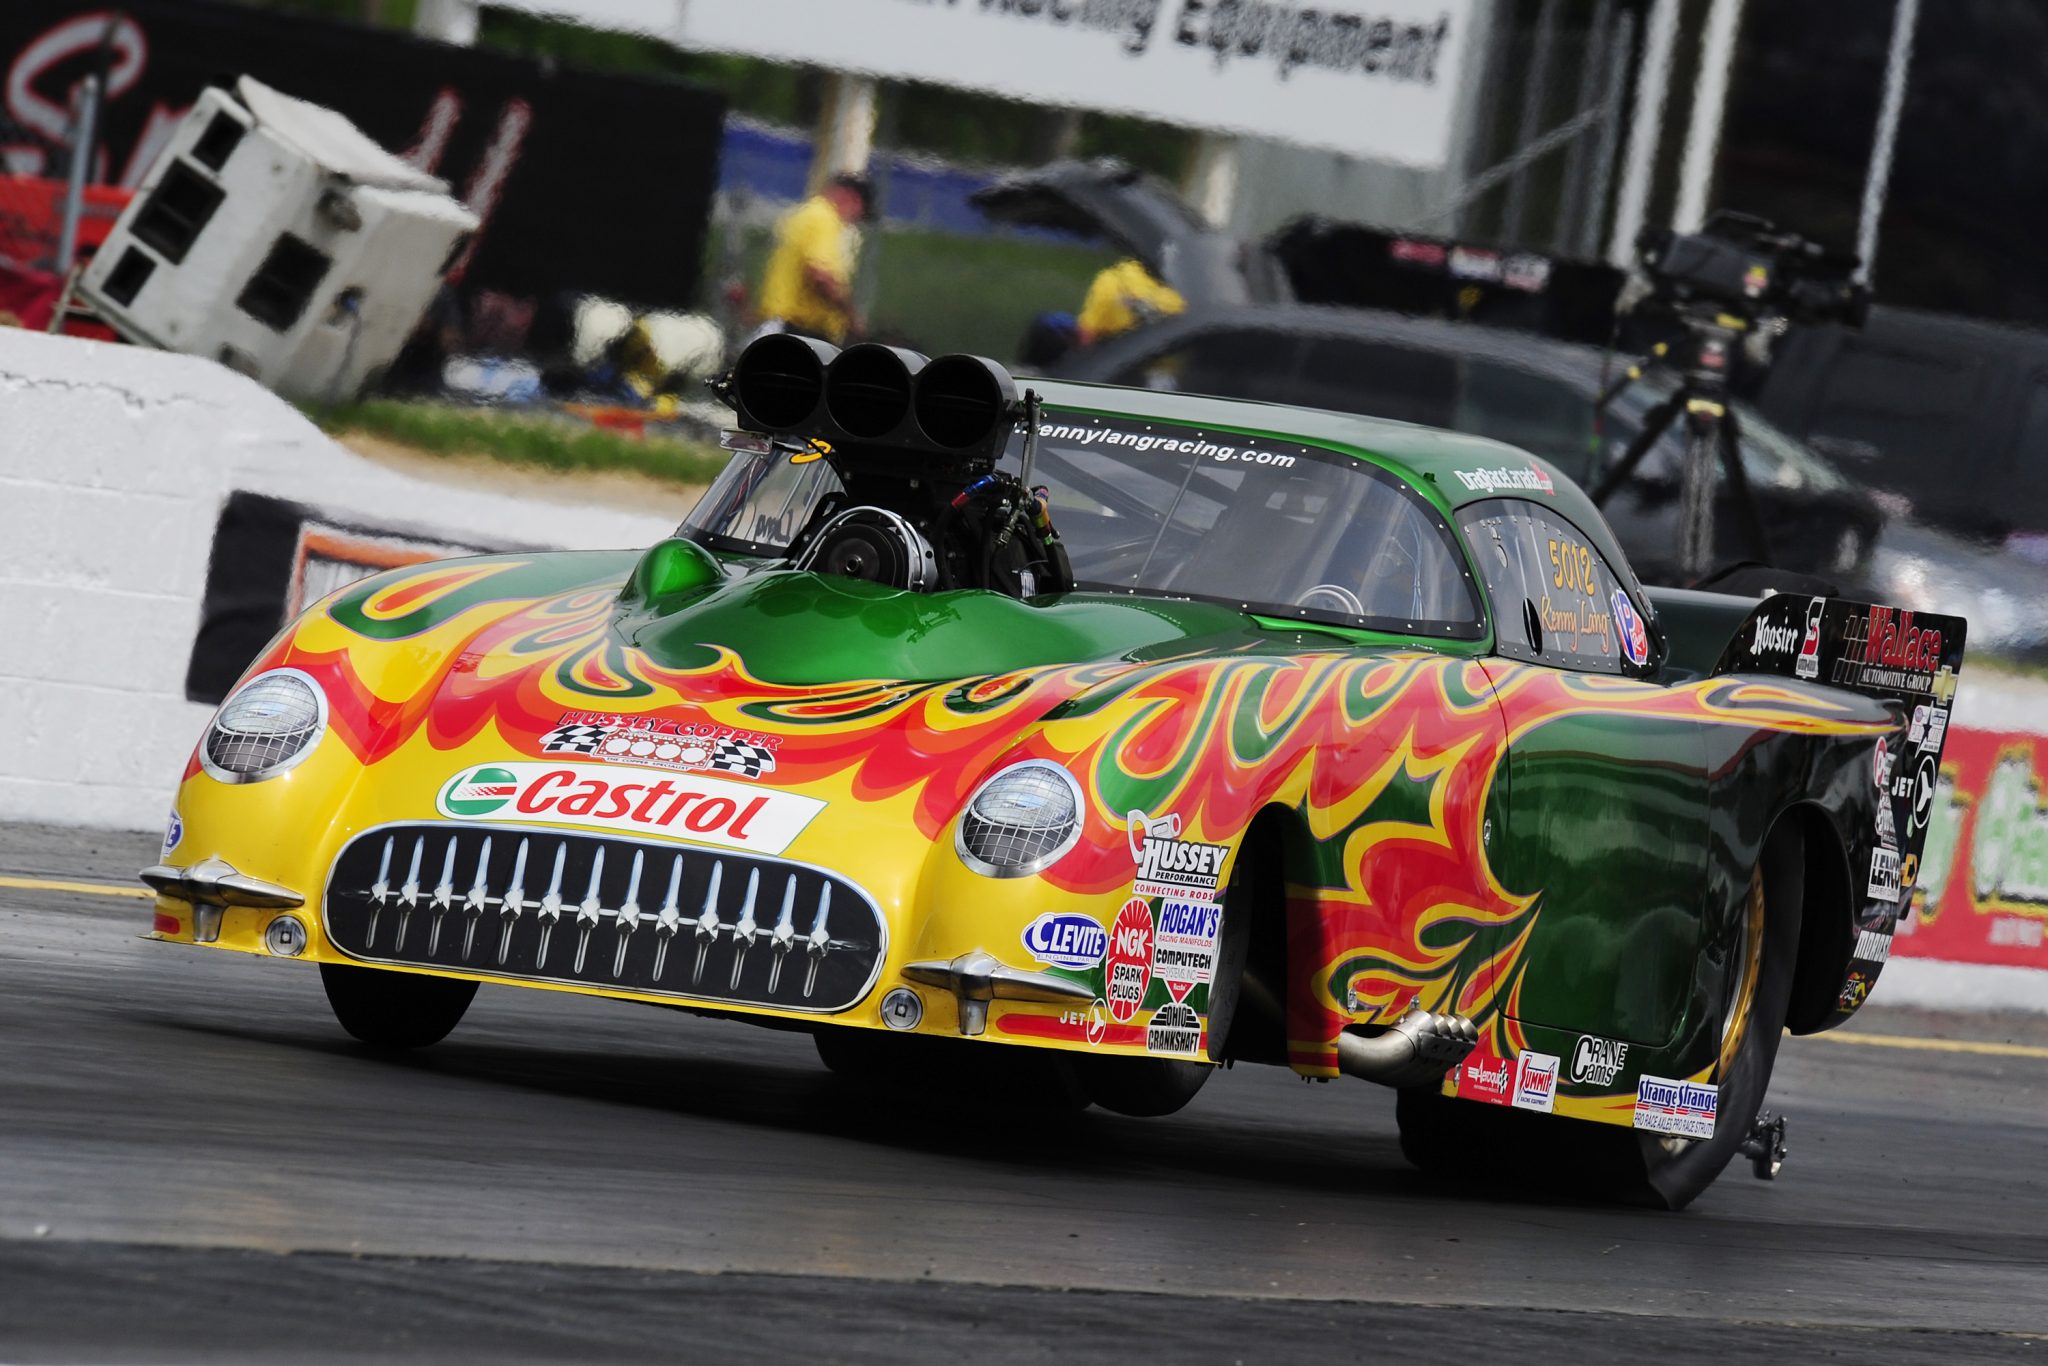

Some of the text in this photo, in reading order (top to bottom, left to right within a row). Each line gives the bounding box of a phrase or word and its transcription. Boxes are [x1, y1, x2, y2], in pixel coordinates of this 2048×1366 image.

[1549, 539, 1595, 596] 5012
[1541, 596, 1610, 654] Kenny Lang
[1750, 616, 1798, 655] Hoosier
[1865, 604, 1942, 672] Wallace
[1861, 668, 1932, 692] AUTOMOTIVE GROUP
[557, 711, 784, 750] HUSSEY COPPER
[1892, 776, 1914, 798] JET
[516, 770, 769, 840] Castrol
[1137, 838, 1229, 880] HUSSEY
[1134, 883, 1214, 901] CONNECTING RODS
[1155, 871, 1216, 886] PERFORMANCE
[1032, 914, 1105, 956] CLEVITE
[1160, 903, 1219, 938] HOGAN'S
[1116, 926, 1150, 959] NGK
[1159, 934, 1213, 948] RACING MANIFOLDS
[1113, 965, 1142, 983] SPARK
[1156, 948, 1212, 970] COMPUTECH
[1111, 983, 1140, 1001] PLUGS
[1059, 1010, 1086, 1026] JET
[1166, 1006, 1187, 1028] OHIO
[1148, 1029, 1199, 1053] CRANKSHAFT
[1572, 1036, 1628, 1081] CRANE
[1519, 1055, 1556, 1093] SUMMIT
[1637, 1078, 1678, 1108] Strange
[1677, 1083, 1717, 1112] Strange
